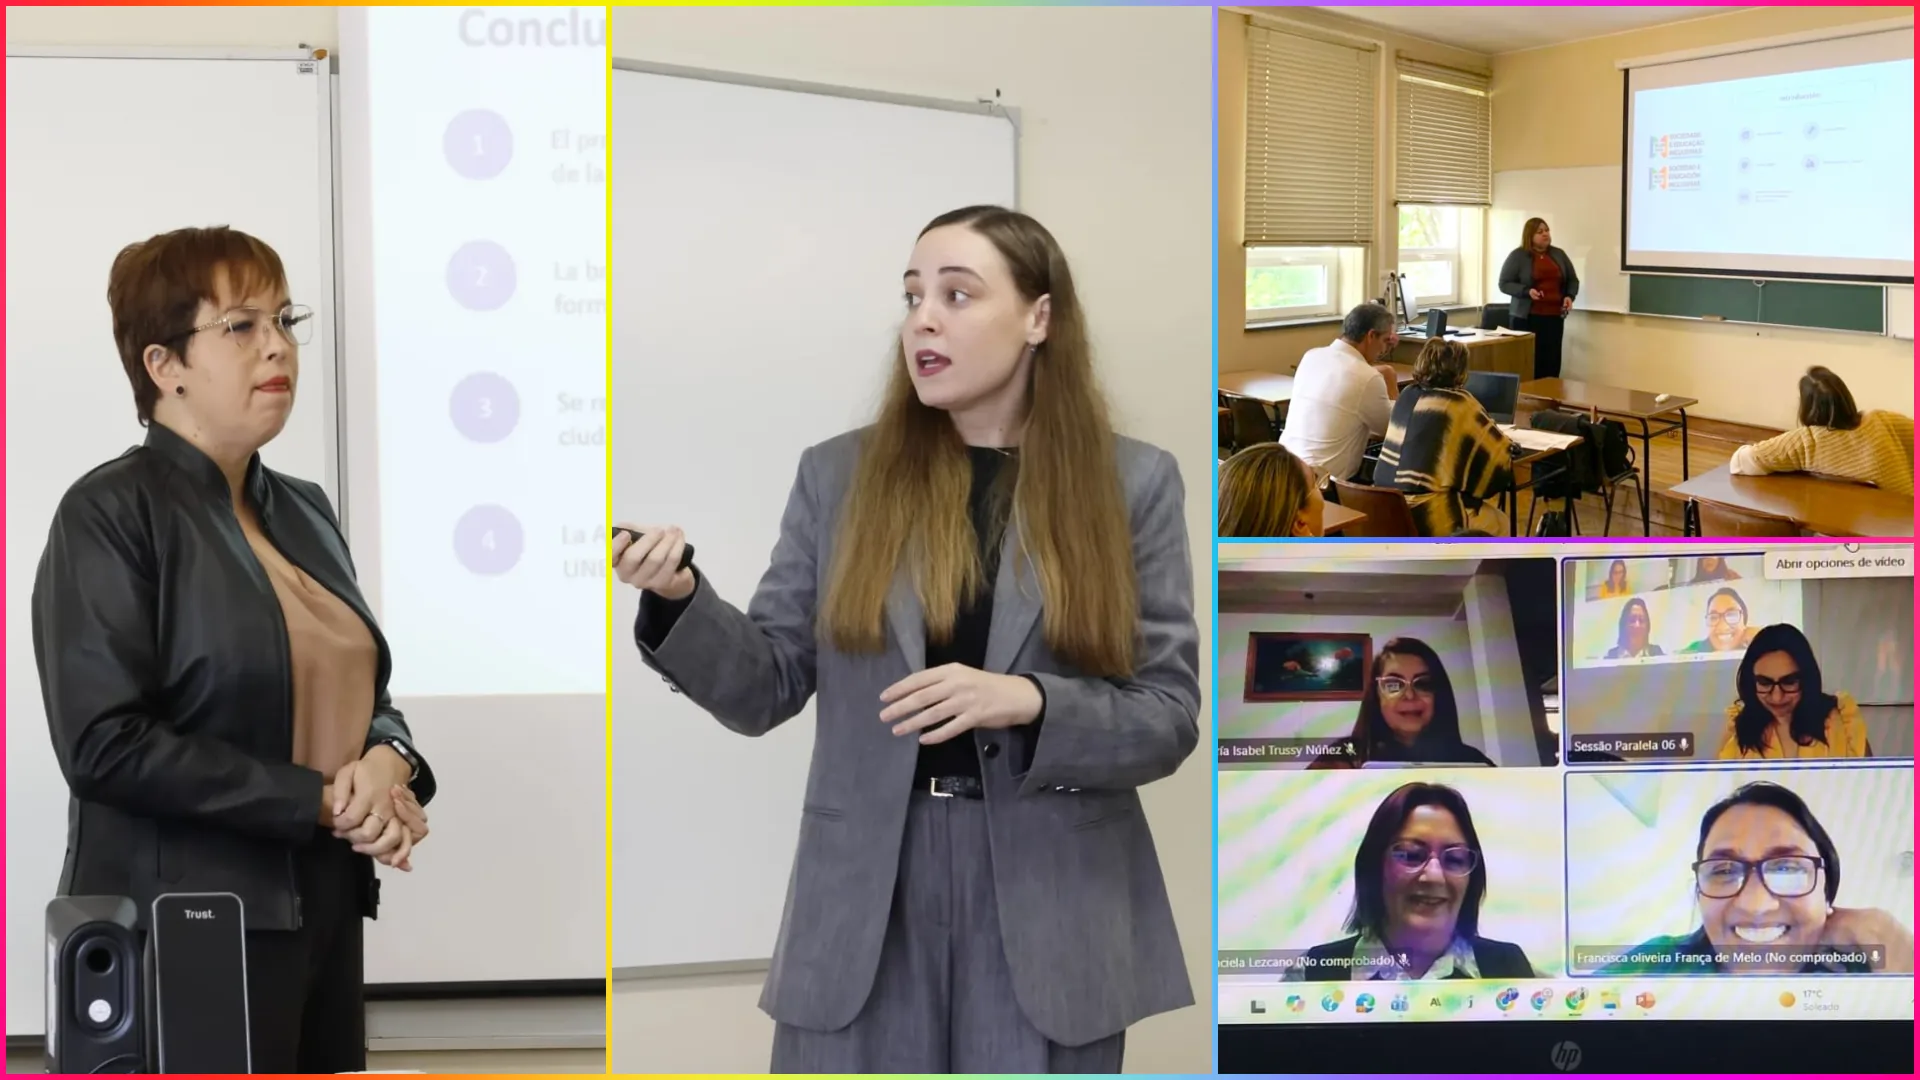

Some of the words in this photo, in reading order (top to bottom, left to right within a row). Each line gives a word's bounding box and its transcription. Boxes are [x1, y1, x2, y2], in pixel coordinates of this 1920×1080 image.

[472, 134, 485, 155] 1
[551, 129, 570, 150] El
[551, 163, 580, 183] de
[475, 266, 489, 287] 2
[554, 261, 579, 281] La
[477, 397, 493, 419] 3
[557, 391, 583, 414] Se
[481, 529, 497, 551] 4
[561, 524, 586, 545] La
[1776, 558, 1802, 569] Abrir
[1805, 559, 1855, 571] opciones
[1858, 557, 1872, 567] de
[1875, 556, 1906, 567] vídeo
[1232, 745, 1265, 756] Isabel
[1268, 744, 1303, 757] Trussy
[1305, 743, 1342, 755] Núñez
[1574, 740, 1612, 752] Sessão
[1615, 740, 1659, 751] Paralela
[1661, 739, 1676, 750] 06
[1249, 956, 1294, 968] Lezcano
[1296, 956, 1317, 968] (No
[1320, 955, 1395, 968] comprobado)
[1577, 952, 1628, 963] Francisca
[1630, 952, 1672, 963] oliveira
[1675, 952, 1712, 965] França
[1715, 952, 1729, 963] de
[1733, 952, 1762, 963] Melo
[1765, 952, 1786, 963] (No
[1789, 952, 1867, 965] comprobado)
[1803, 989, 1823, 998] 17°C
[1803, 1002, 1840, 1012] Soleado
[1550, 1040, 1582, 1071] hp
